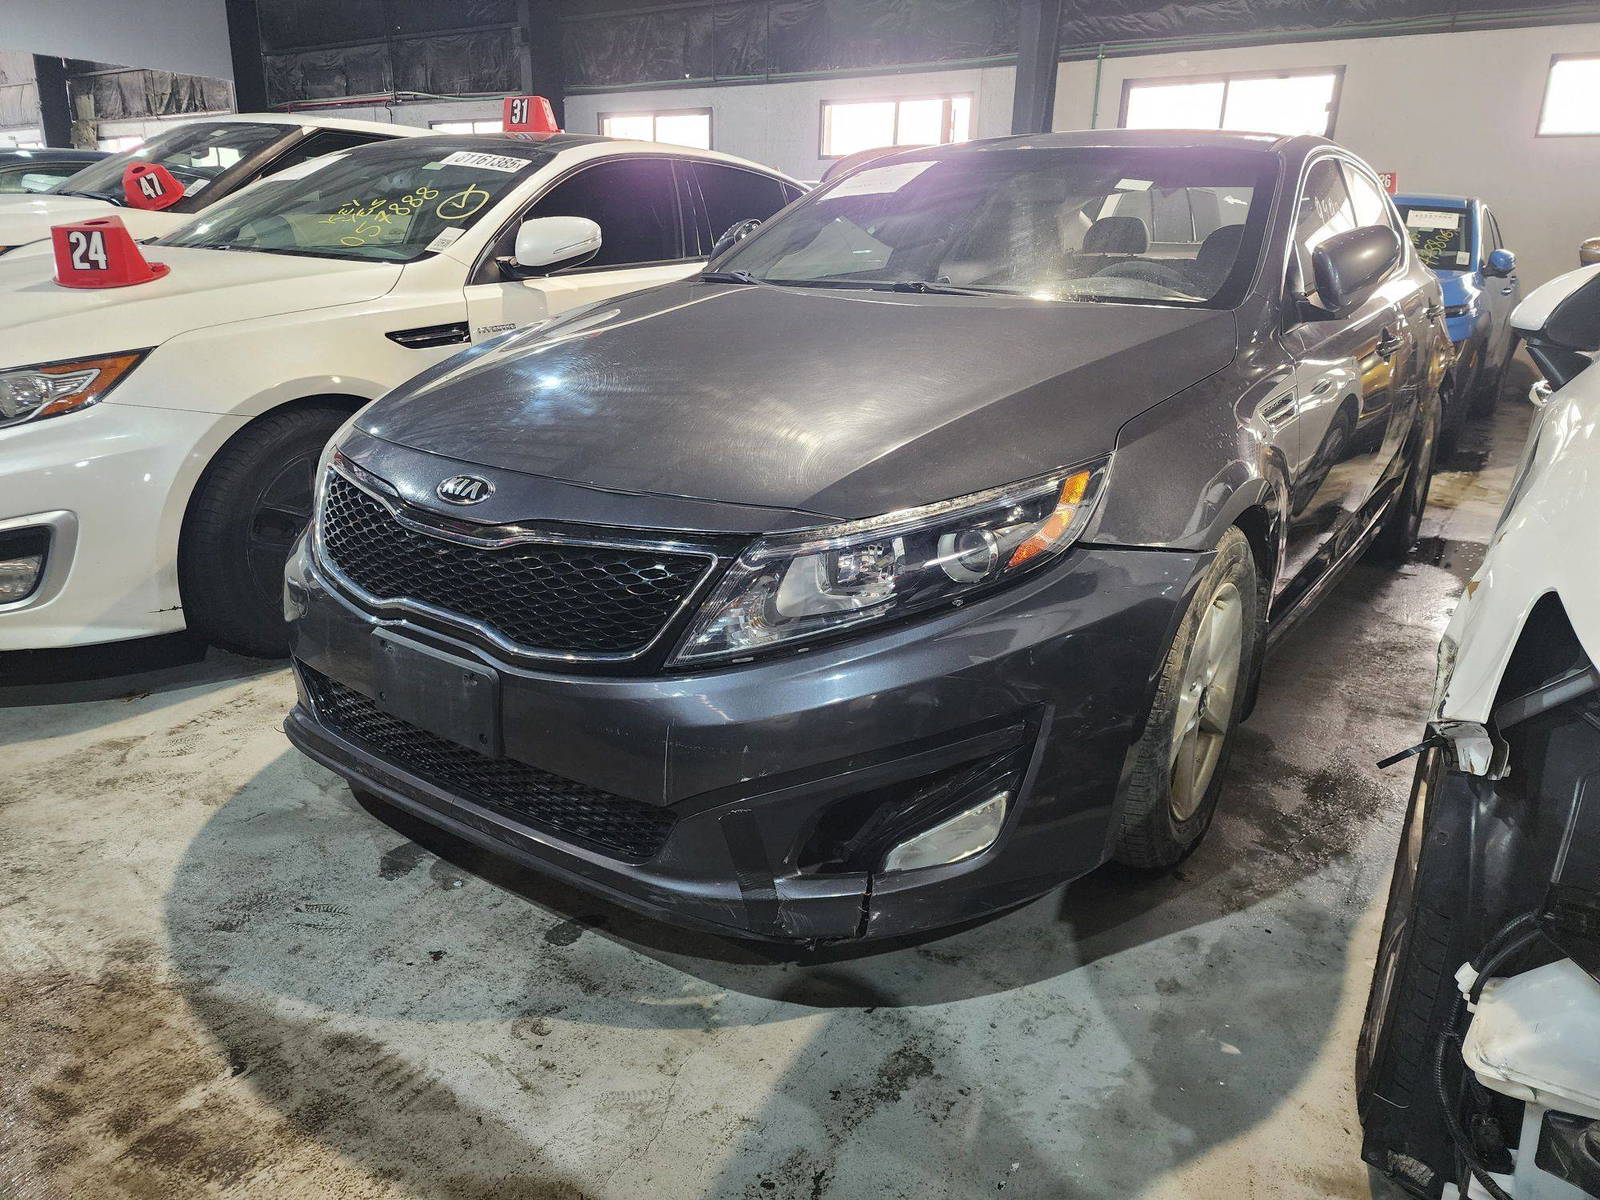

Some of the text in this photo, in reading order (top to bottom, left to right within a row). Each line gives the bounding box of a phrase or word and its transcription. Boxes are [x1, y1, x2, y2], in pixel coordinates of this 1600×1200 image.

[511, 98, 528, 124] 31
[139, 172, 163, 199] 47
[68, 230, 107, 270] 24
[441, 477, 483, 500] KIA
